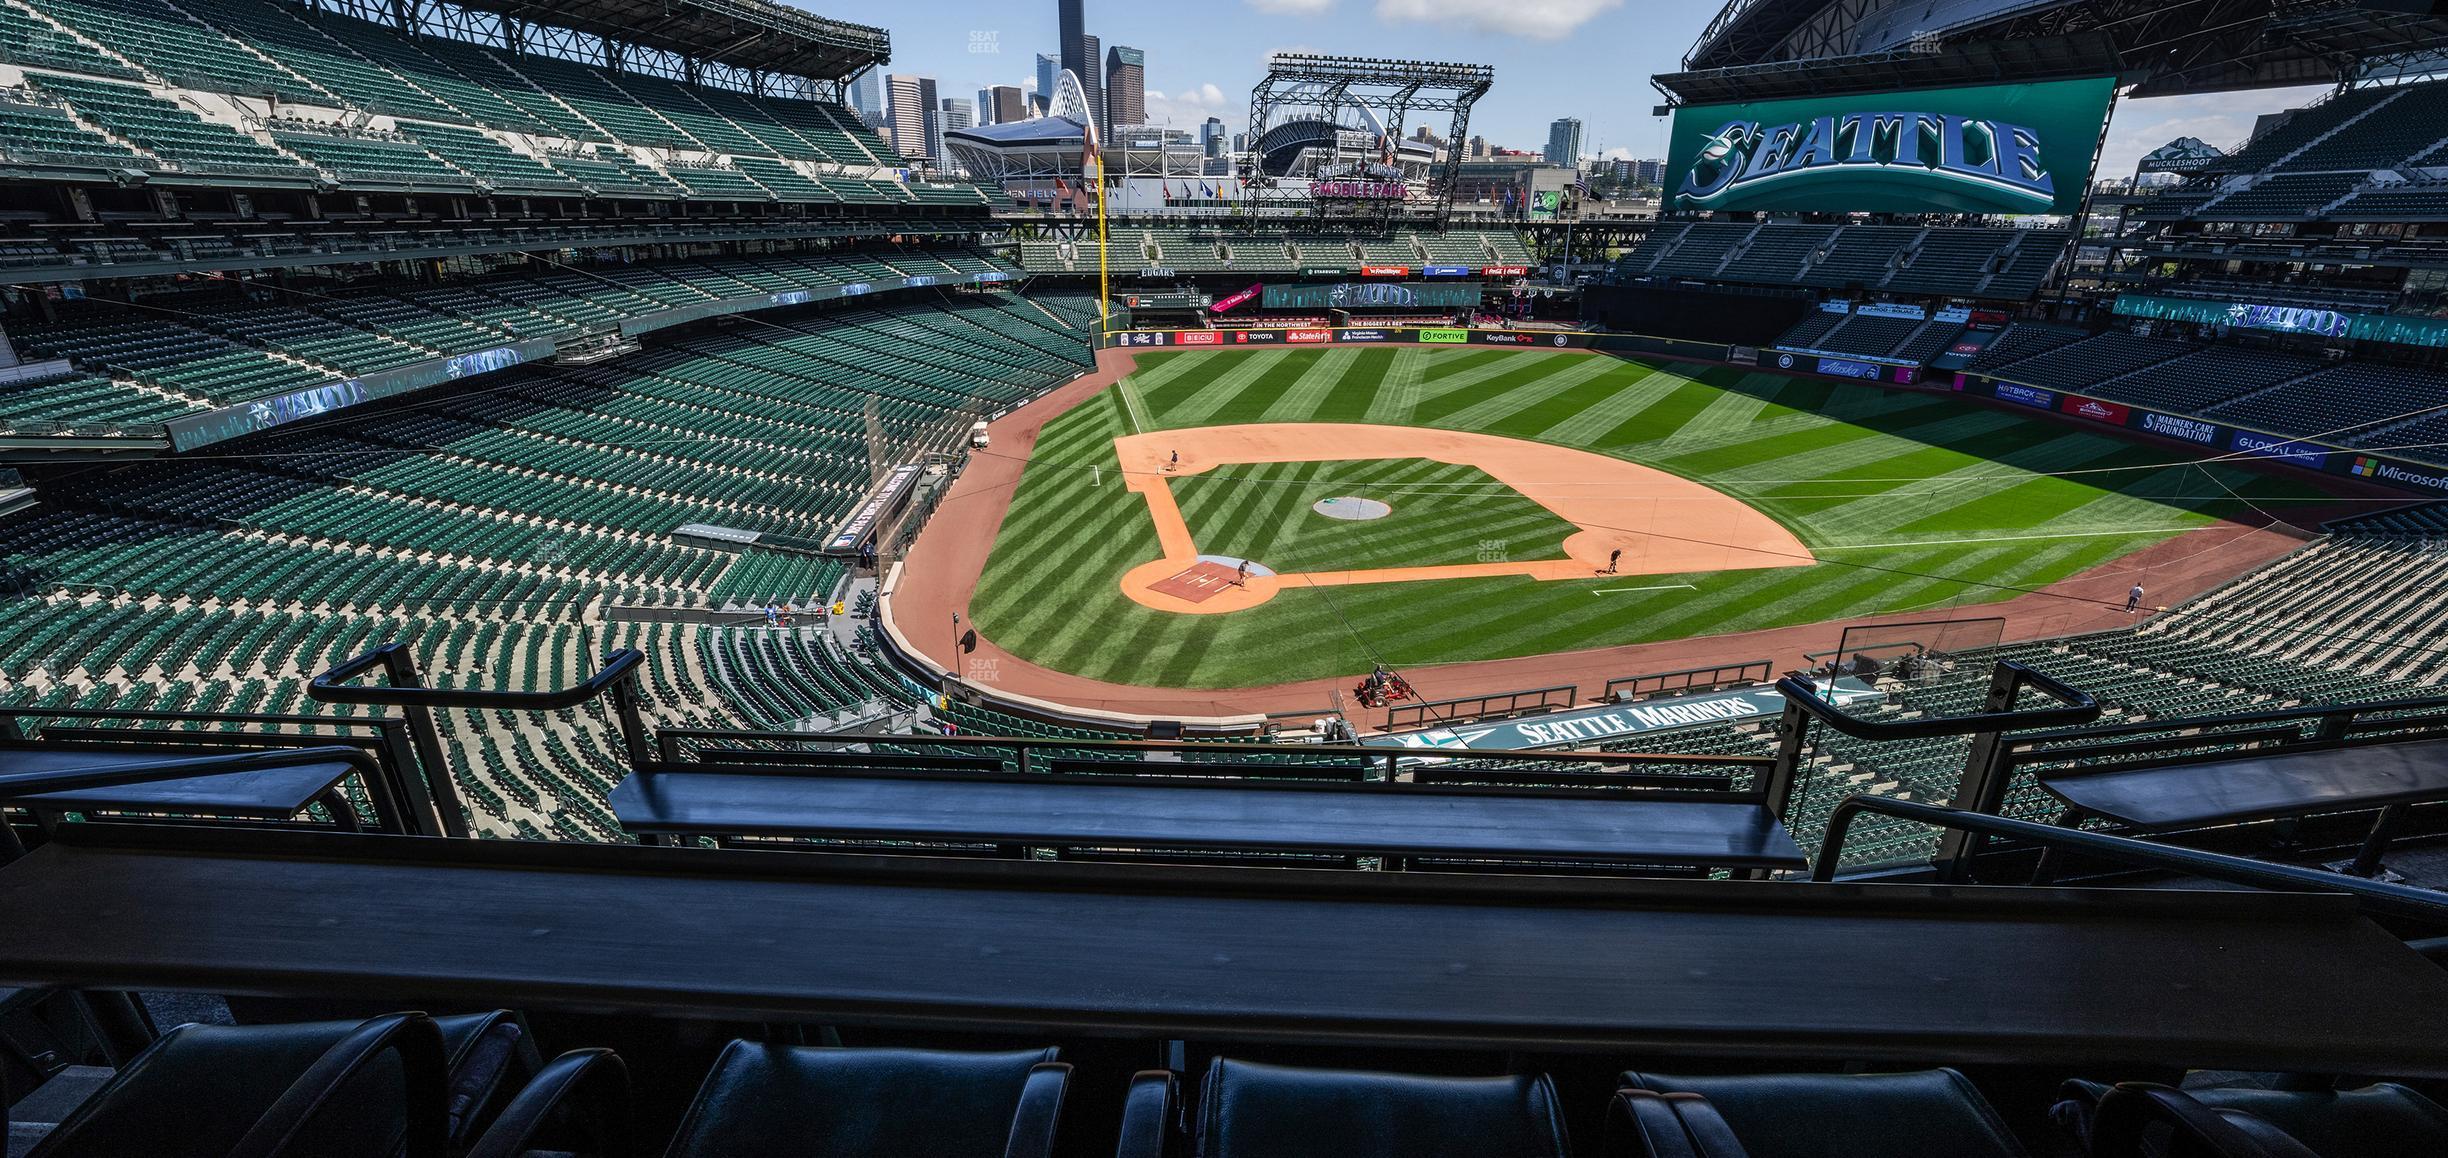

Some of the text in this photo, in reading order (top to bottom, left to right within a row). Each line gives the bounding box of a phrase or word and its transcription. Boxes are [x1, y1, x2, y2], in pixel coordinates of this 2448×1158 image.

[1676, 112, 2054, 203] SEATTLE
[2148, 158, 2212, 168] MUCKLESHOOT
[1373, 182, 1408, 198] PARK
[1186, 334, 1213, 342] BECU
[1486, 334, 1517, 343] KeyBank
[1821, 361, 1860, 376] Alaska
[1998, 384, 2035, 397] HATBACK
[2154, 422, 2213, 443] FOUNDATION
[2159, 415, 2216, 434] MARINERS CARE
[2239, 437, 2291, 456] GLOBAL
[1516, 697, 1758, 744] SEATTLE MARINERS
